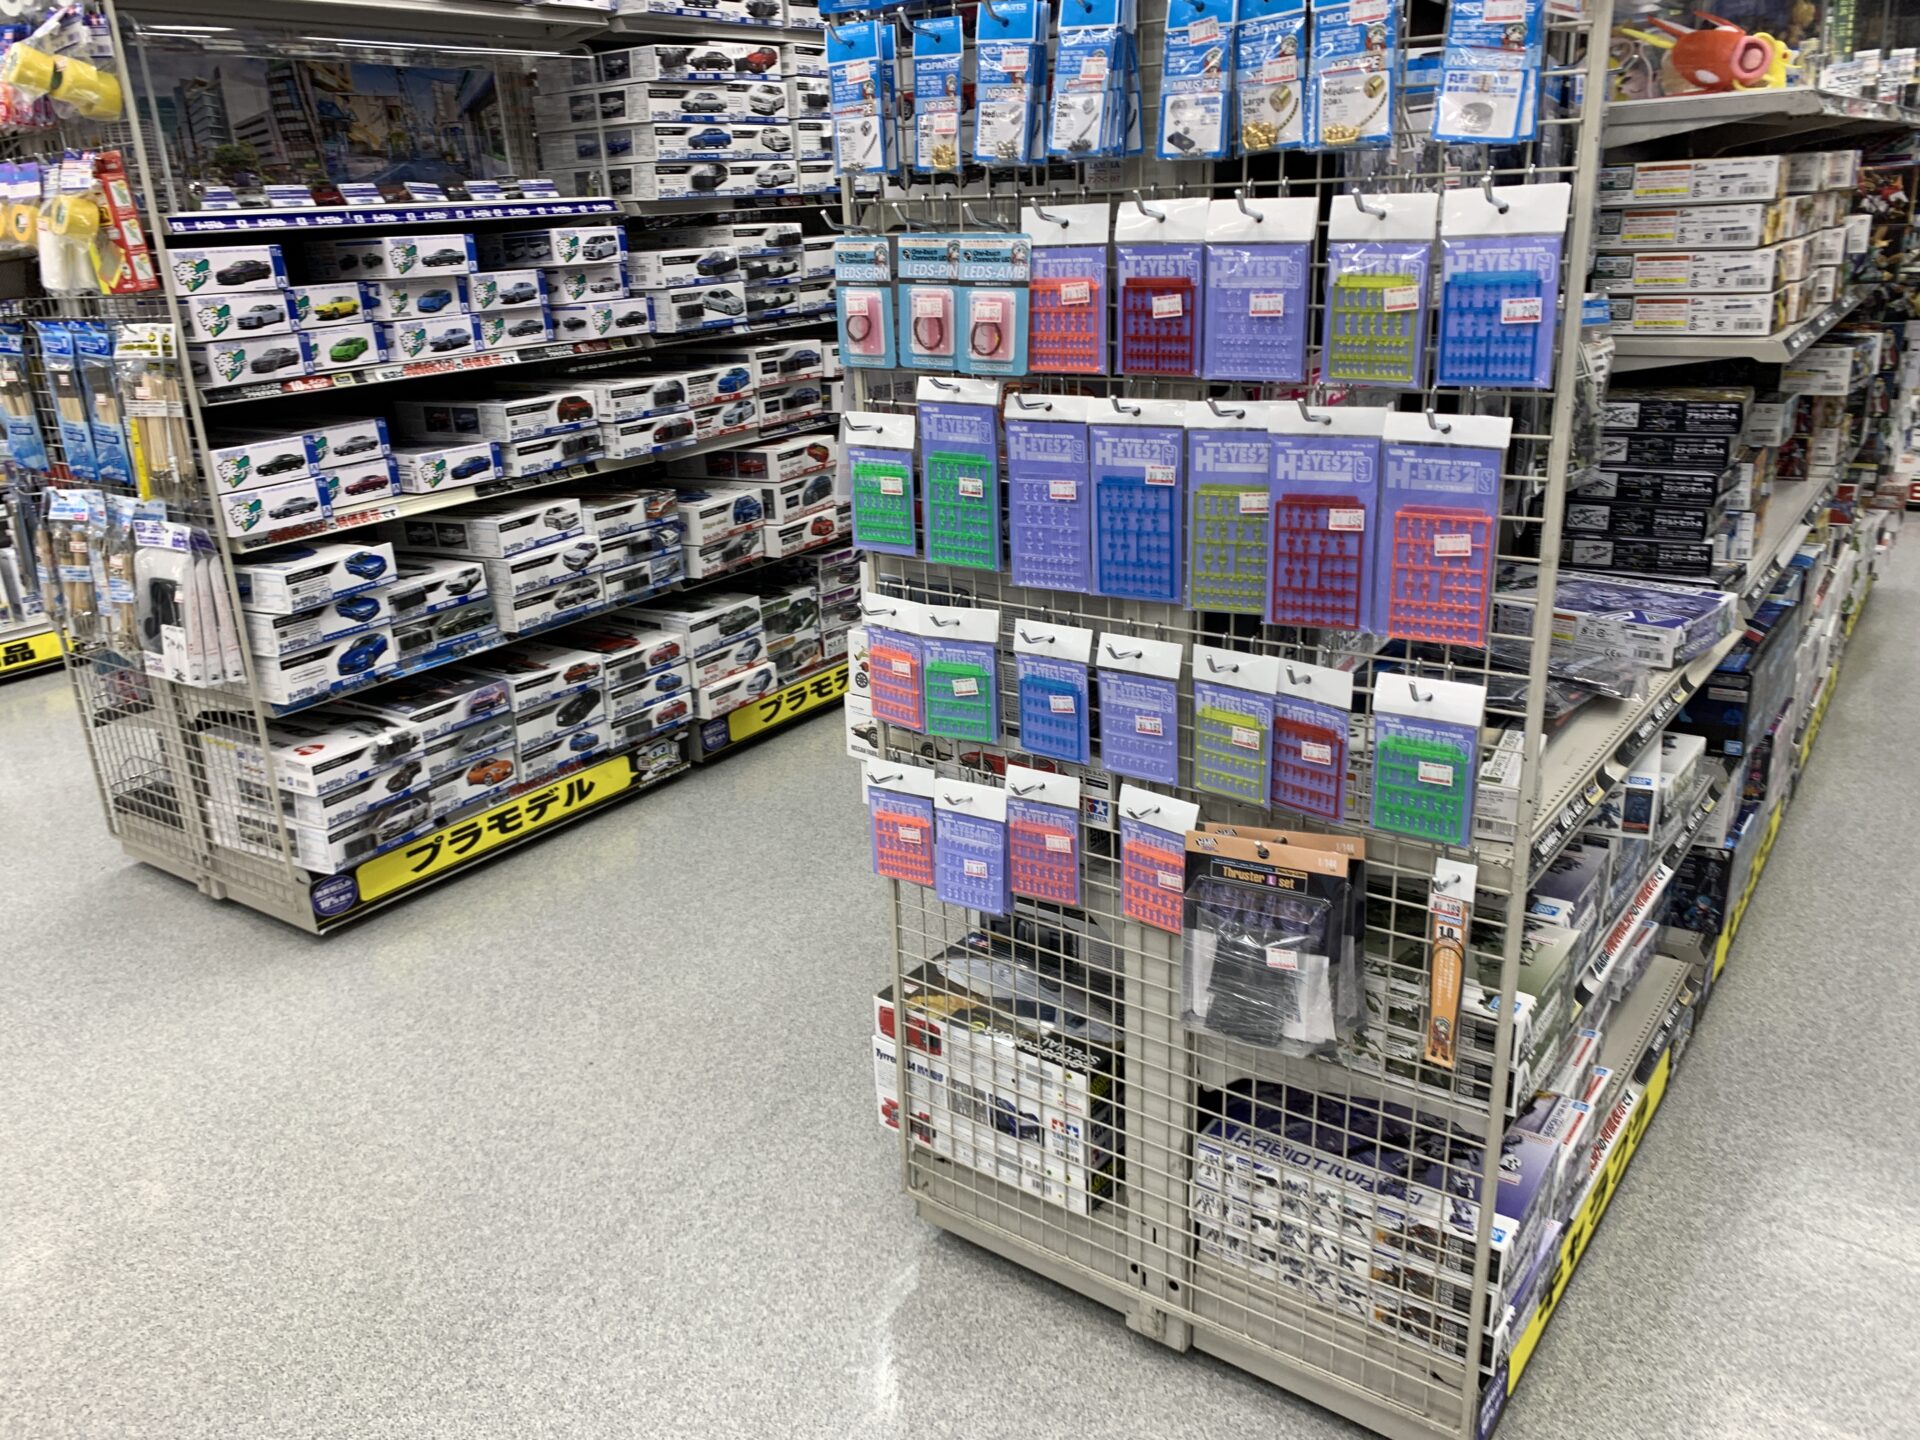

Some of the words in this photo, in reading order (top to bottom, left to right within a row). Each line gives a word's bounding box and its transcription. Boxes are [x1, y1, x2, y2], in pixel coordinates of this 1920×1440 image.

[964, 265, 1026, 279] LEDS-AMB
[406, 778, 595, 872] プラモデル
[1222, 865, 1265, 884] Thruster
[1278, 879, 1295, 890] set
[1234, 1132, 1329, 1171] RABIOT
